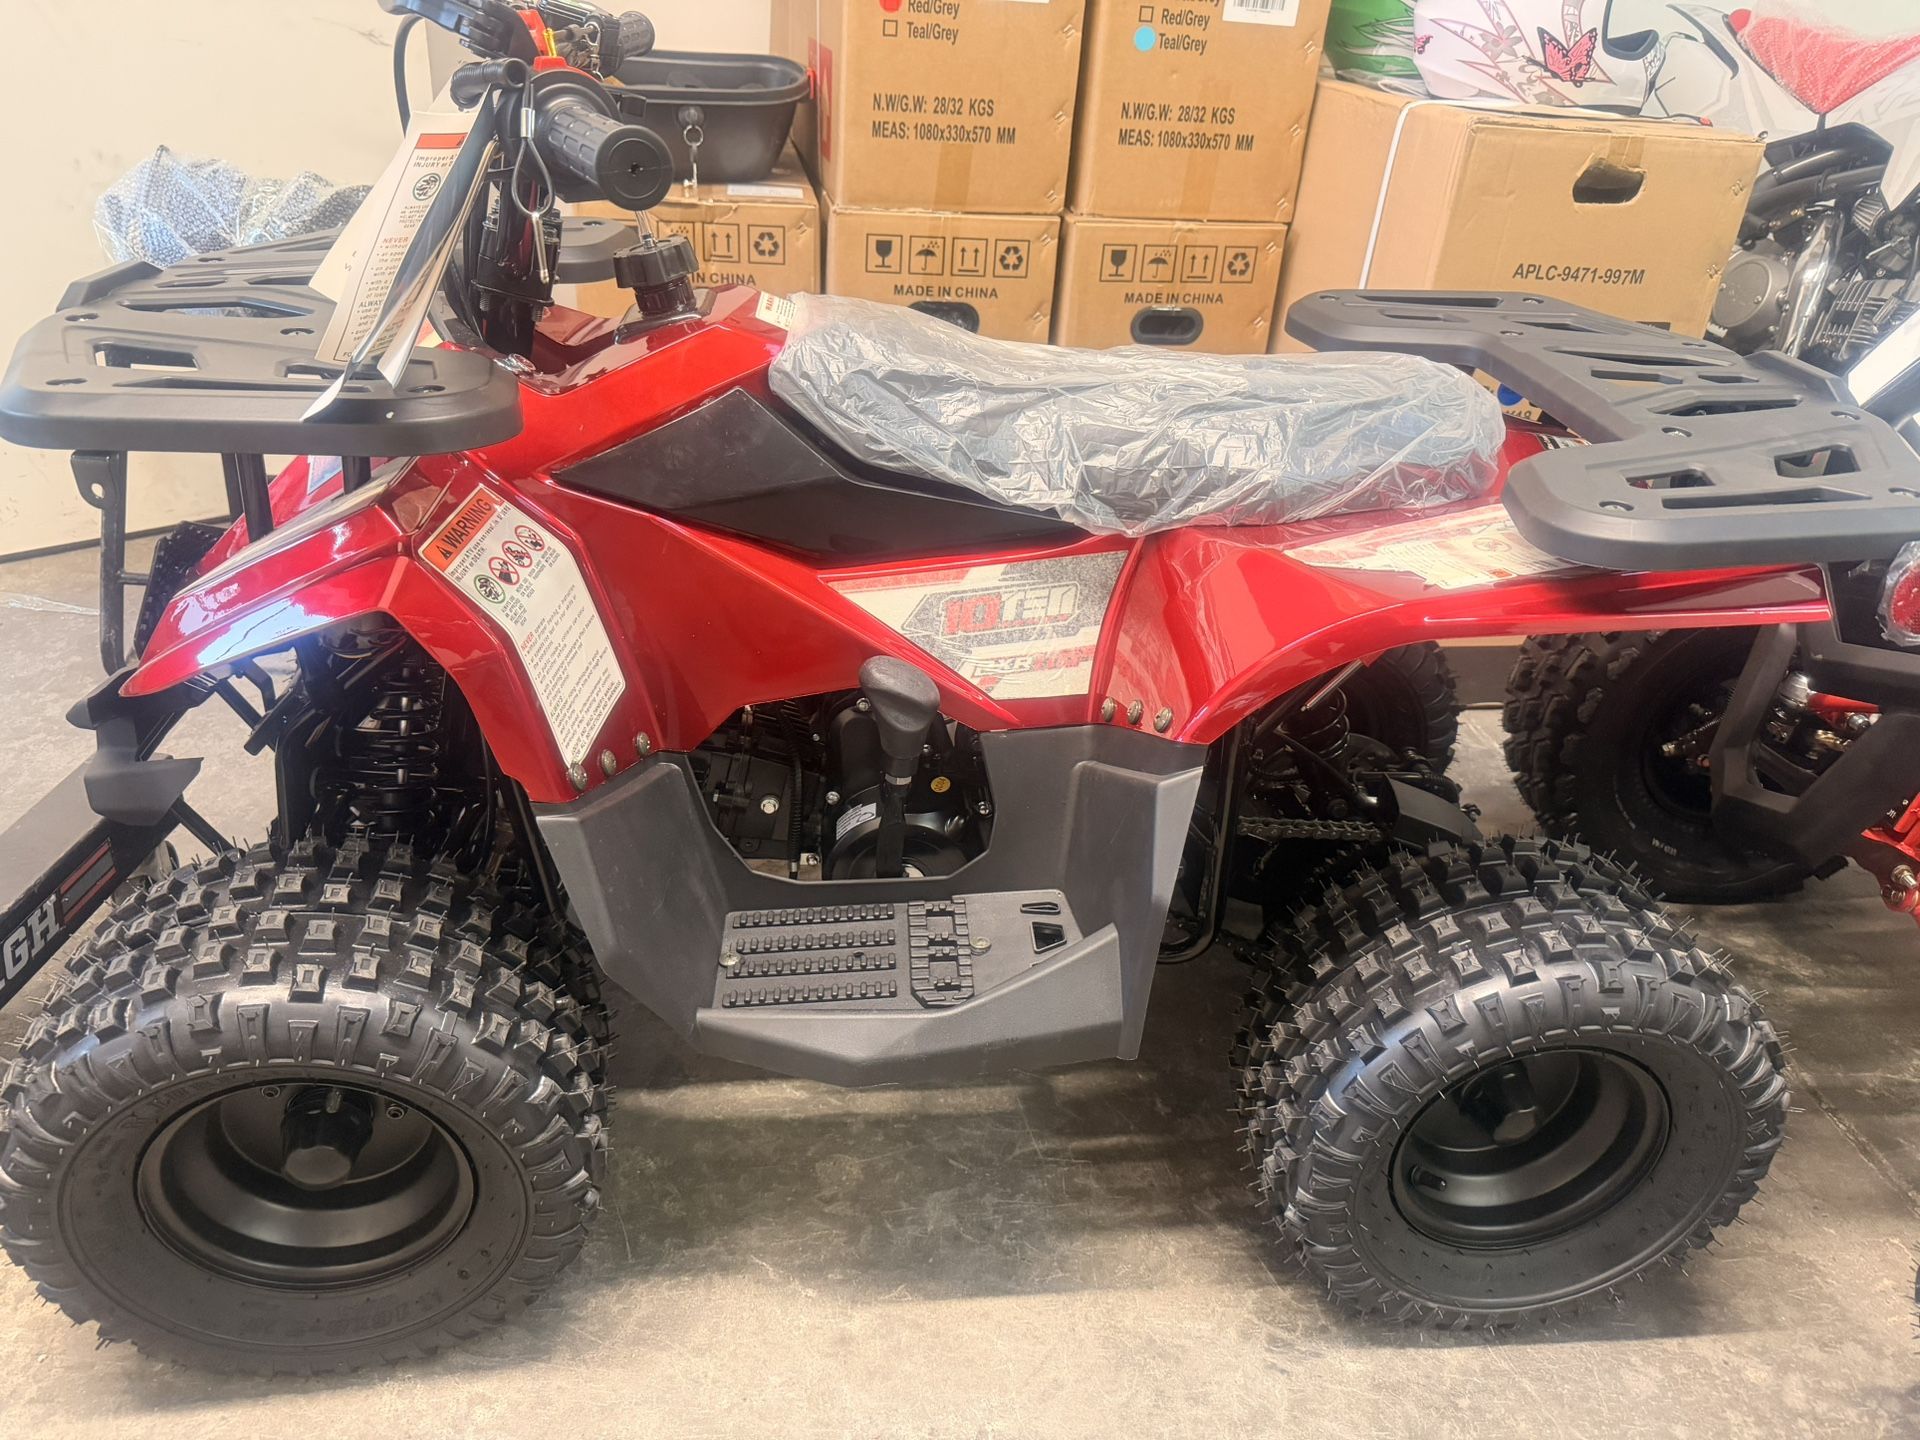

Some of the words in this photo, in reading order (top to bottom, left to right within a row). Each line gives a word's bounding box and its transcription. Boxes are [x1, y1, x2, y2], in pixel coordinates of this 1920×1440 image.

[908, 0, 960, 20] Red/Grey
[1161, 8, 1210, 31] Red/Grey
[907, 21, 959, 45] Teal/Grey
[1158, 32, 1207, 56] Teal/Grey
[873, 93, 927, 114] N.W/G.W:
[933, 96, 963, 115] 28/32
[969, 98, 994, 117] KGS
[1121, 102, 1173, 121] N.W/G.W:
[1178, 105, 1206, 123] 28/32
[1211, 106, 1235, 125] KGS
[872, 120, 910, 140] MEAS:
[913, 122, 991, 143] 1080x330x570
[997, 127, 1016, 144] MM
[1118, 128, 1154, 147] MEAS:
[1158, 130, 1231, 150] 1080x330x570
[1235, 134, 1254, 151] MM
[691, 273, 705, 284] IN
[710, 273, 756, 286] CHINA
[1512, 263, 1645, 285] APLC-9471-997M
[894, 284, 934, 297] MADE
[938, 286, 951, 297] IN
[955, 287, 998, 299] CHINA
[1124, 292, 1162, 304] MADE
[1166, 293, 1179, 304] IN
[1182, 293, 1223, 304] CHINA
[441, 498, 492, 549] WARNING
